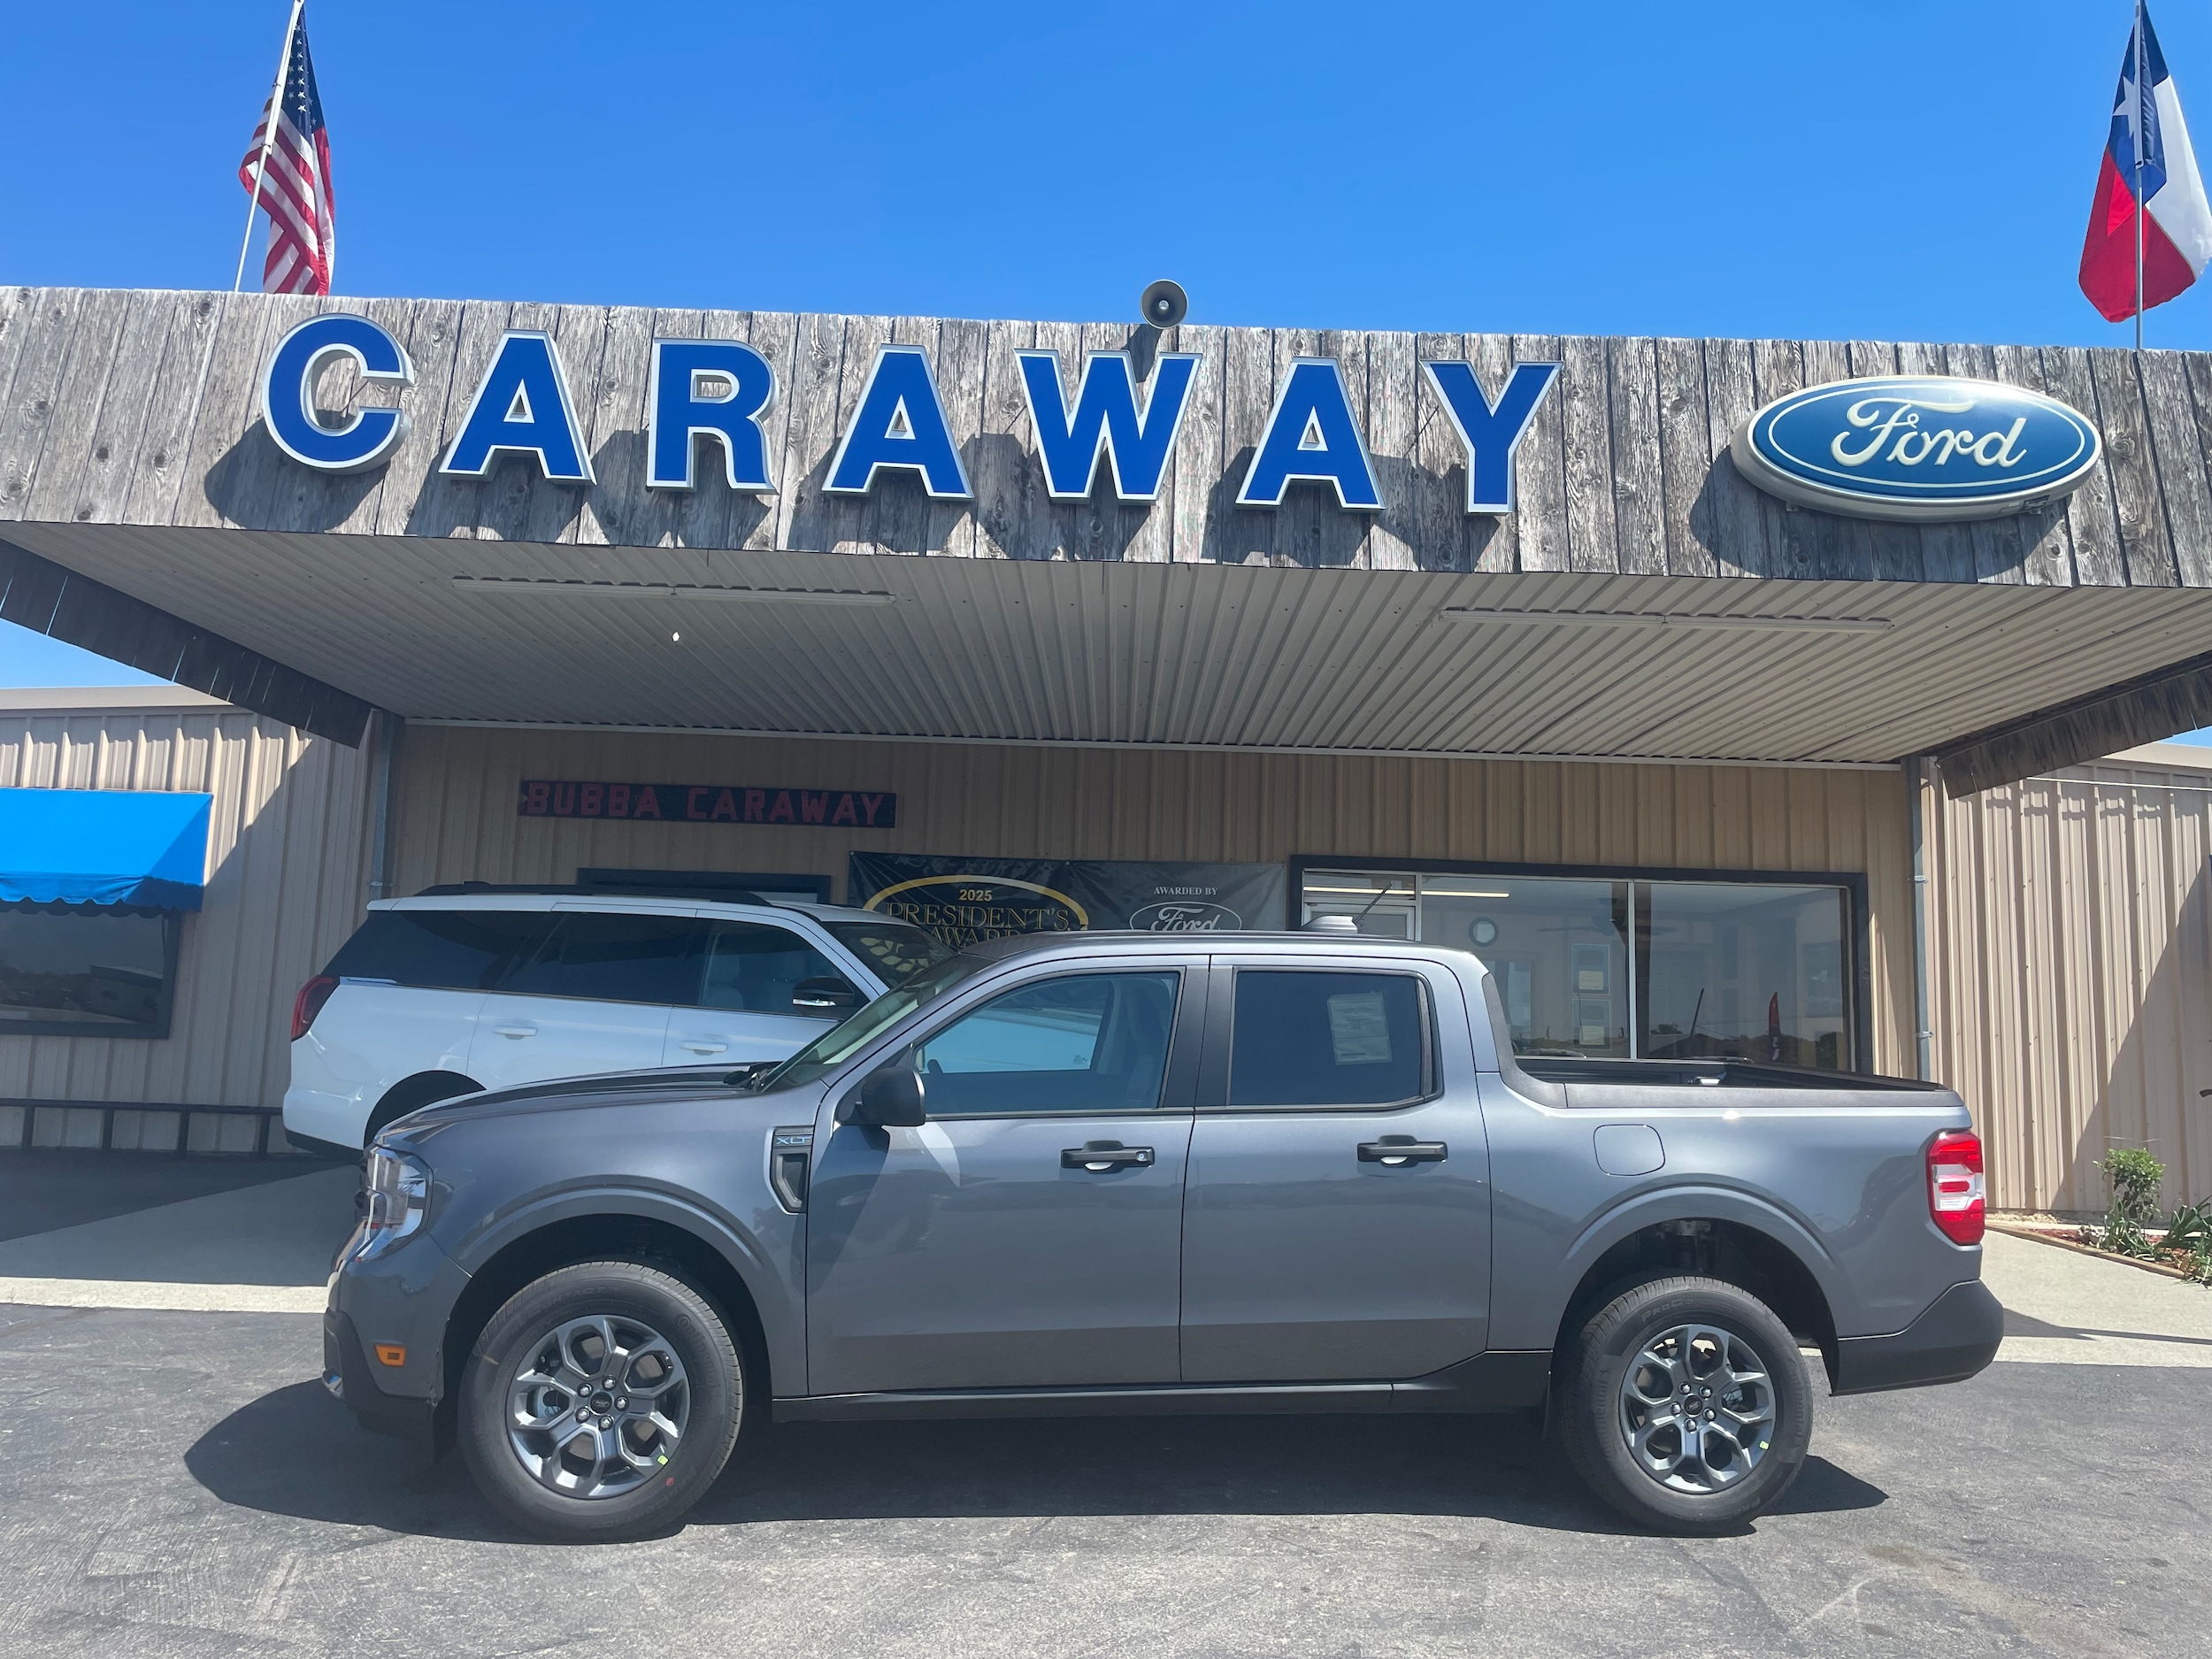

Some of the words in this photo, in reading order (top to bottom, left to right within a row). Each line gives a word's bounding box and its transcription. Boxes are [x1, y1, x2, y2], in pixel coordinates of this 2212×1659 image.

[263, 312, 1563, 517] CARAWAY
[1830, 397, 2027, 467] Ford
[526, 781, 662, 819] BUBBA
[687, 787, 885, 826] CARAWAY
[958, 888, 993, 902] 2025
[1153, 886, 1202, 896] AWARDED
[1204, 887, 1218, 895] BY
[886, 902, 1070, 932] PRESIDENT'S
[1150, 906, 1221, 931] Ford
[931, 926, 1021, 949] AWA
[775, 1136, 812, 1145] XLT
